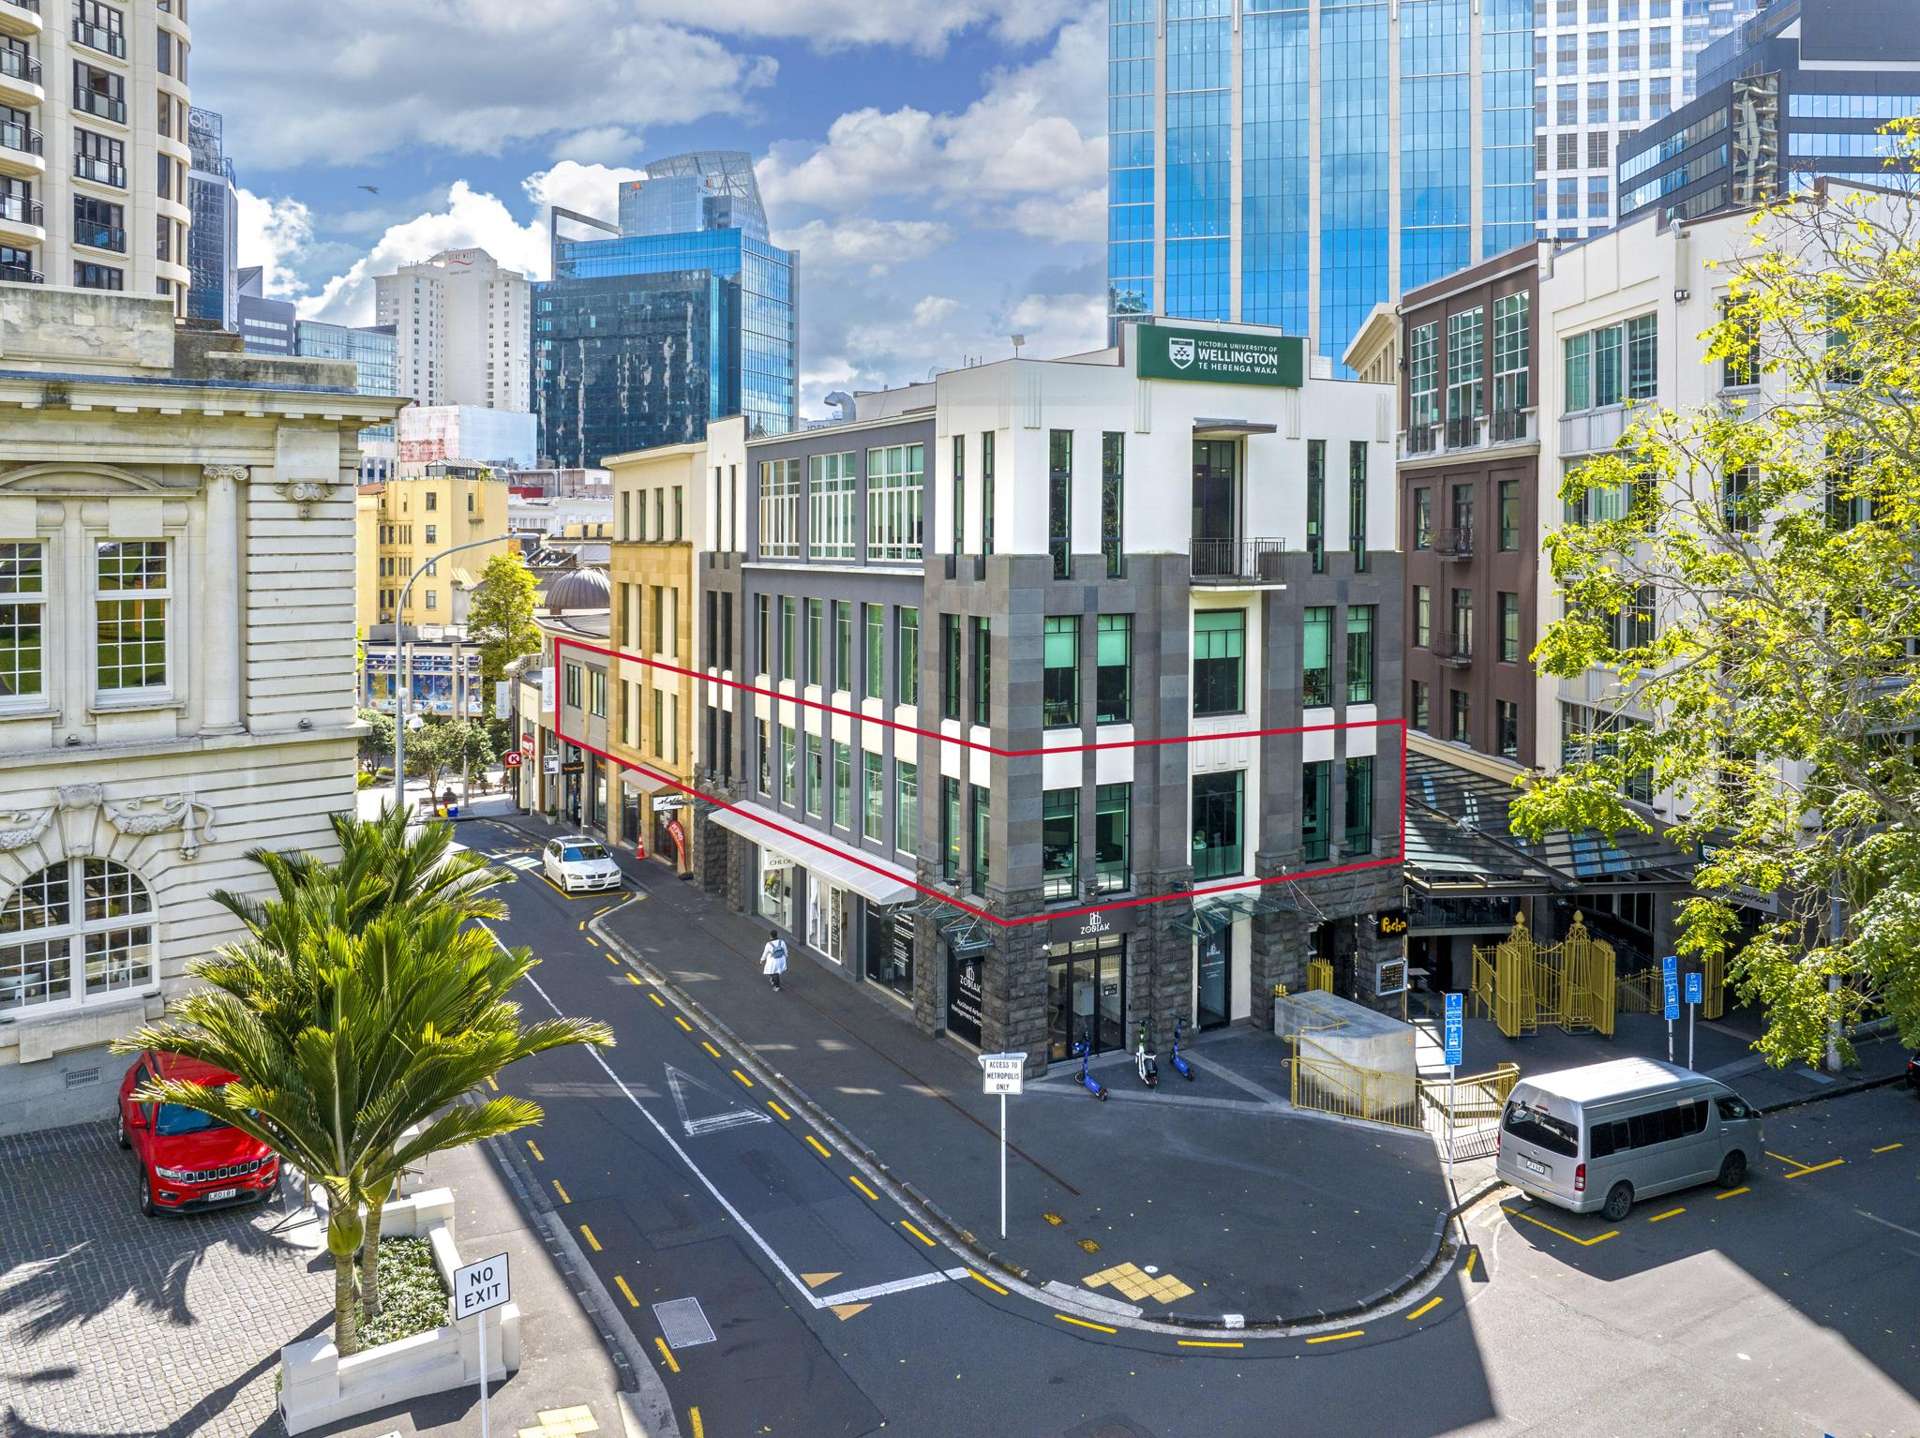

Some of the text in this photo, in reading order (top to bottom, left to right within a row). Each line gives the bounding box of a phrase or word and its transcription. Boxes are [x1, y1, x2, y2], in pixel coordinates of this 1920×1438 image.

[1197, 340, 1228, 348] VICTORIA
[1229, 343, 1267, 352] UNIVERSITY
[1197, 348, 1278, 366] WELLINGTON
[1198, 362, 1278, 375] TE HERENGA WAKA
[989, 1061, 1018, 1069] ACCESS TO
[986, 1072, 1020, 1080] METROPOLIS
[995, 1083, 1010, 1091] ONLY
[470, 1266, 493, 1287] NO
[464, 1282, 501, 1308] EXIT
